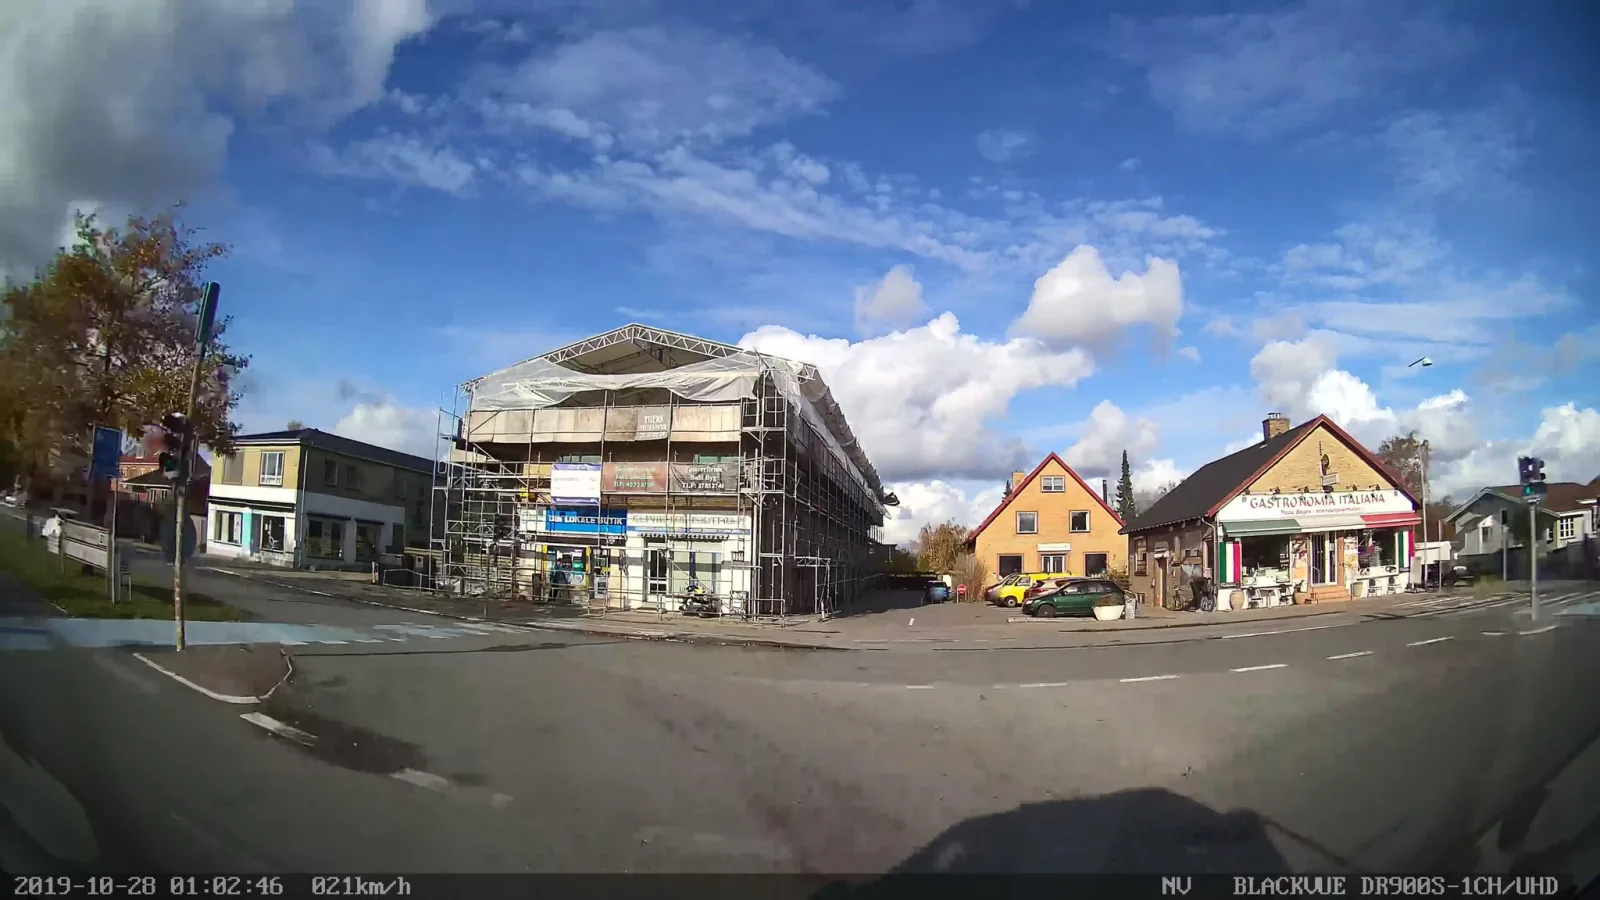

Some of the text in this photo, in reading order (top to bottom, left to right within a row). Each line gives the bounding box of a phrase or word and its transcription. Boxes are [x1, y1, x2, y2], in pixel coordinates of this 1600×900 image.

[1250, 493, 1386, 509] GASTRONOMIA ITALIANA
[565, 516, 596, 524] LOKALE
[598, 517, 623, 525] BUTIK
